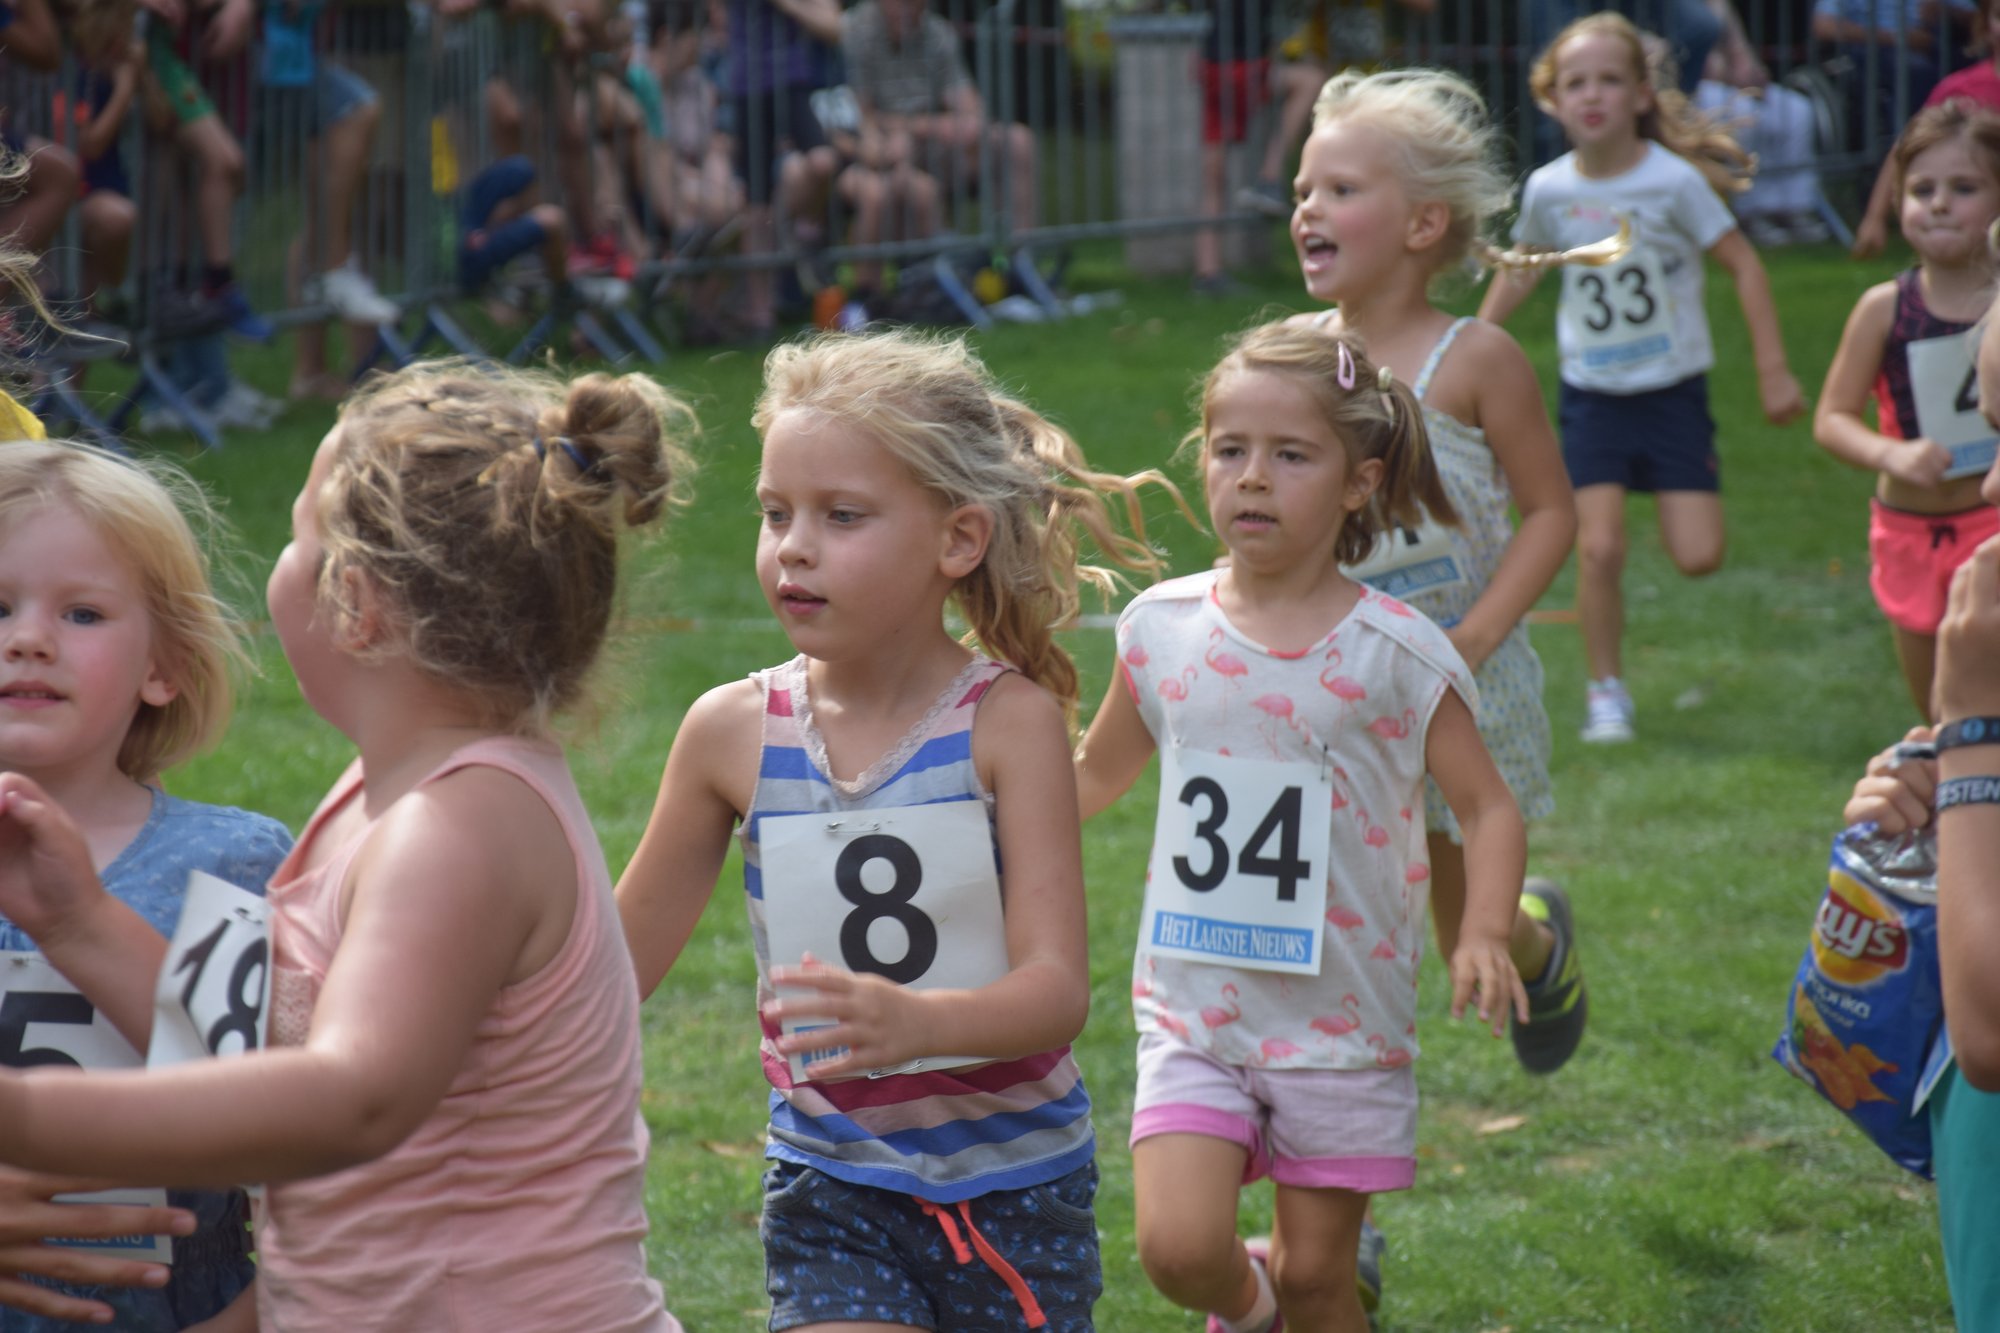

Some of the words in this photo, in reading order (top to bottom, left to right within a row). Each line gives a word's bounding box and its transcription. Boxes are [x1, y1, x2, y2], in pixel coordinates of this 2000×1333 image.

[1576, 264, 1656, 332] 33
[1172, 775, 1311, 902] 34
[835, 834, 938, 985] 8
[1159, 913, 1190, 946] HET
[1190, 918, 1249, 955] LAATSTE
[1250, 926, 1306, 962] NIEUWS
[171, 917, 267, 1058] 18
